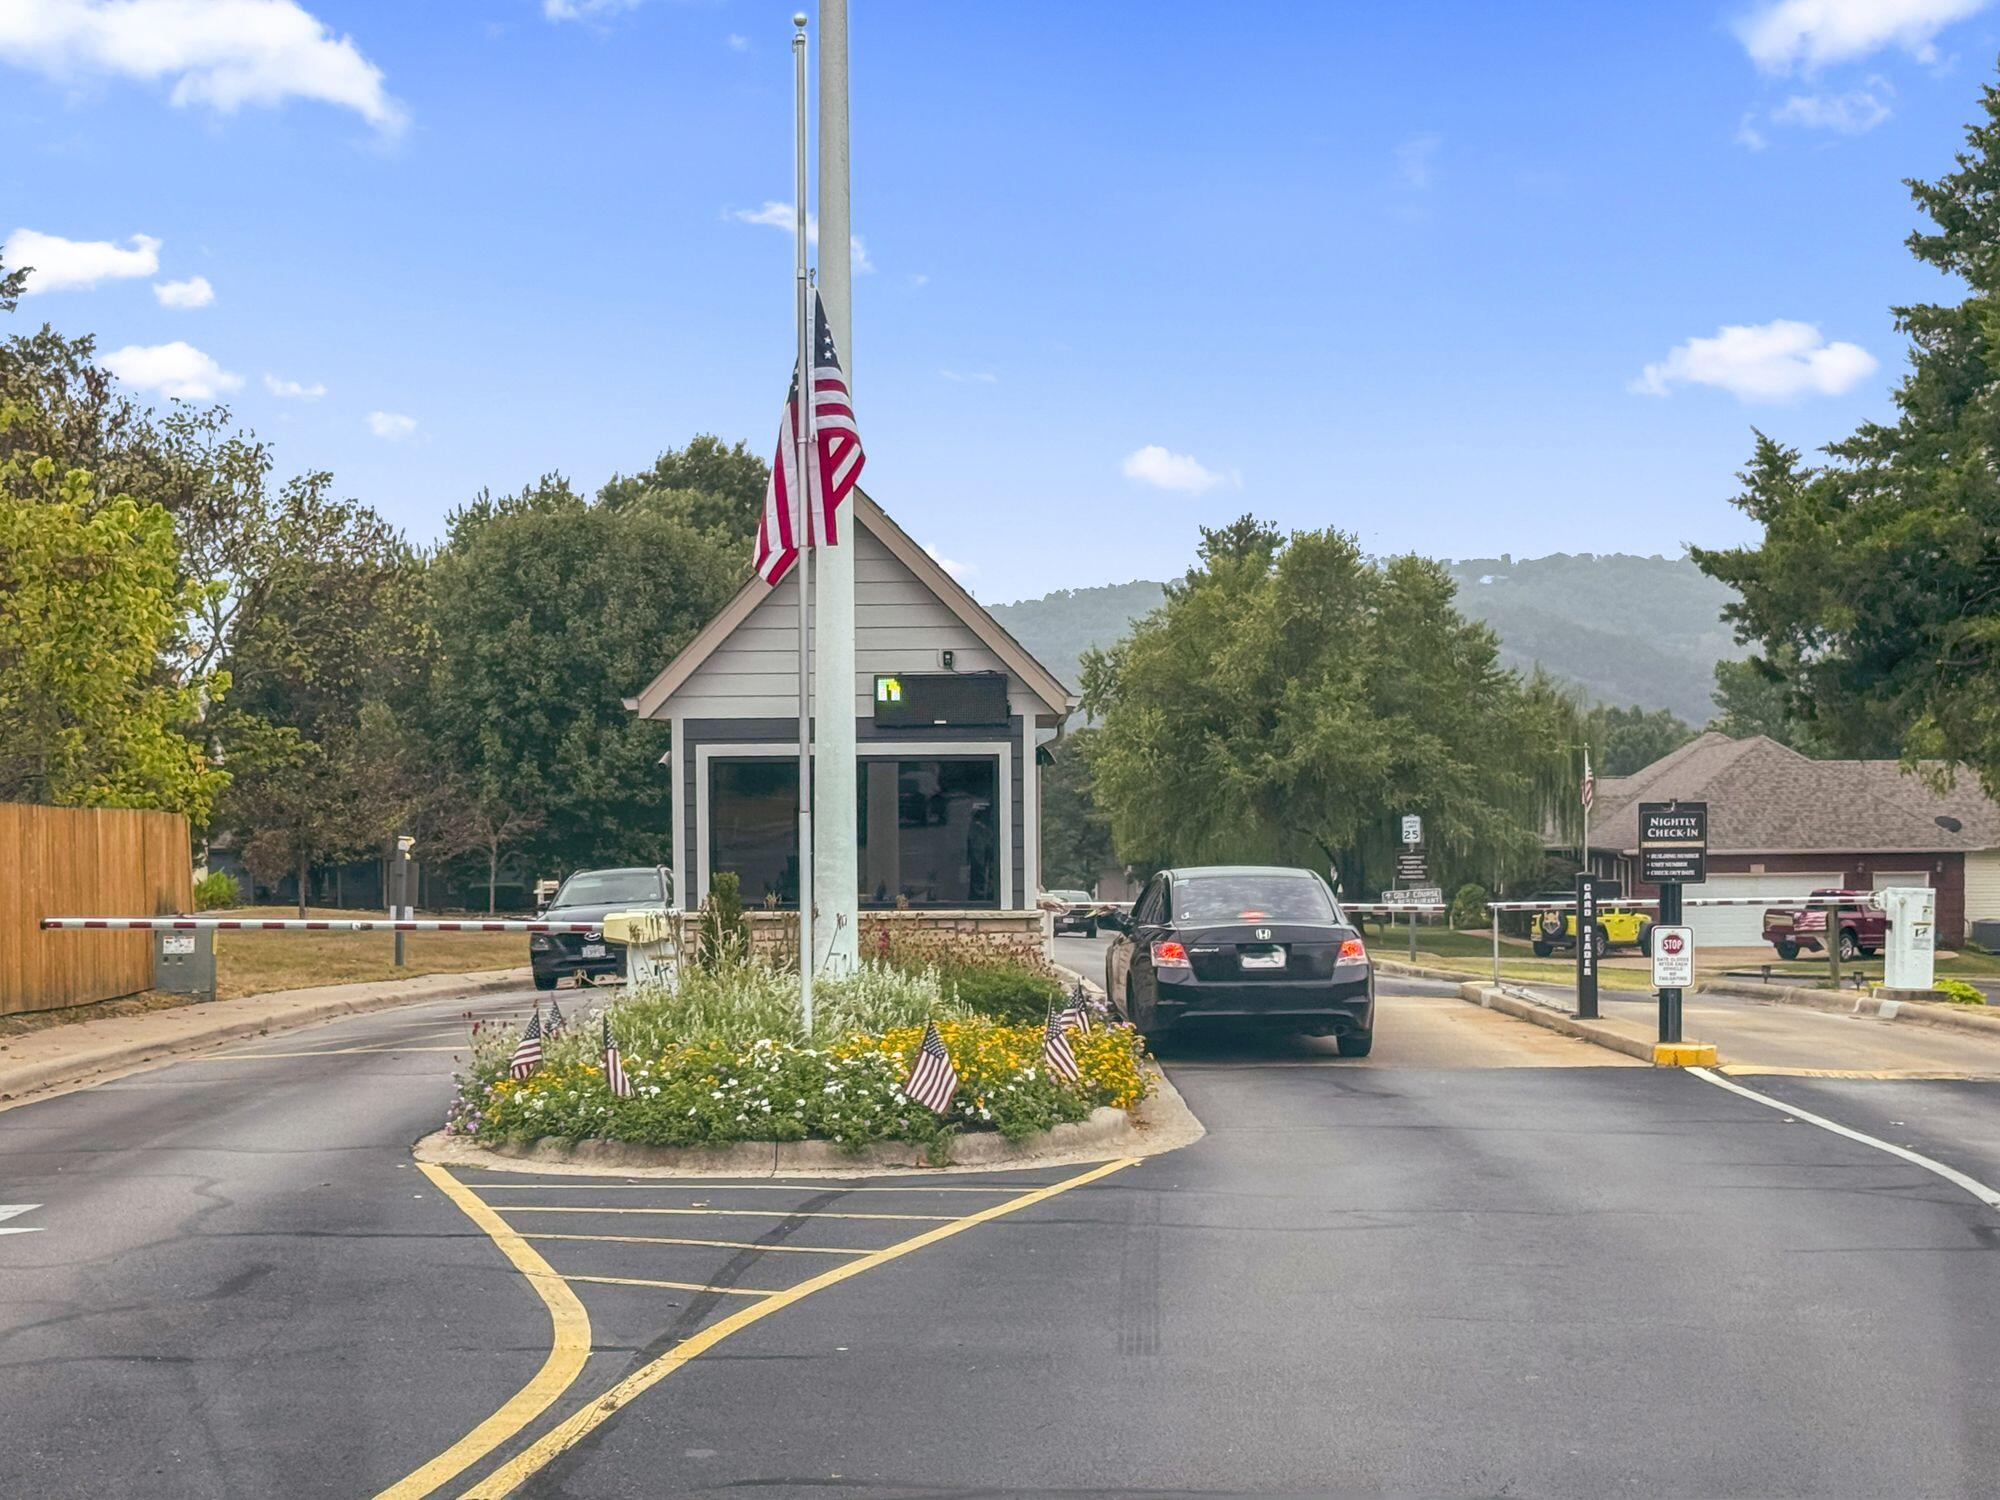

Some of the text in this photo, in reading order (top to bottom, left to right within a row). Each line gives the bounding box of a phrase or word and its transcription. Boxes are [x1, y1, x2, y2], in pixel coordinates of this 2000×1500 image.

[1650, 817, 1697, 827] NIGHTLY
[1404, 830, 1419, 840] 25
[1583, 883, 1592, 976] CARD READER
[1663, 940, 1683, 950] STOP
